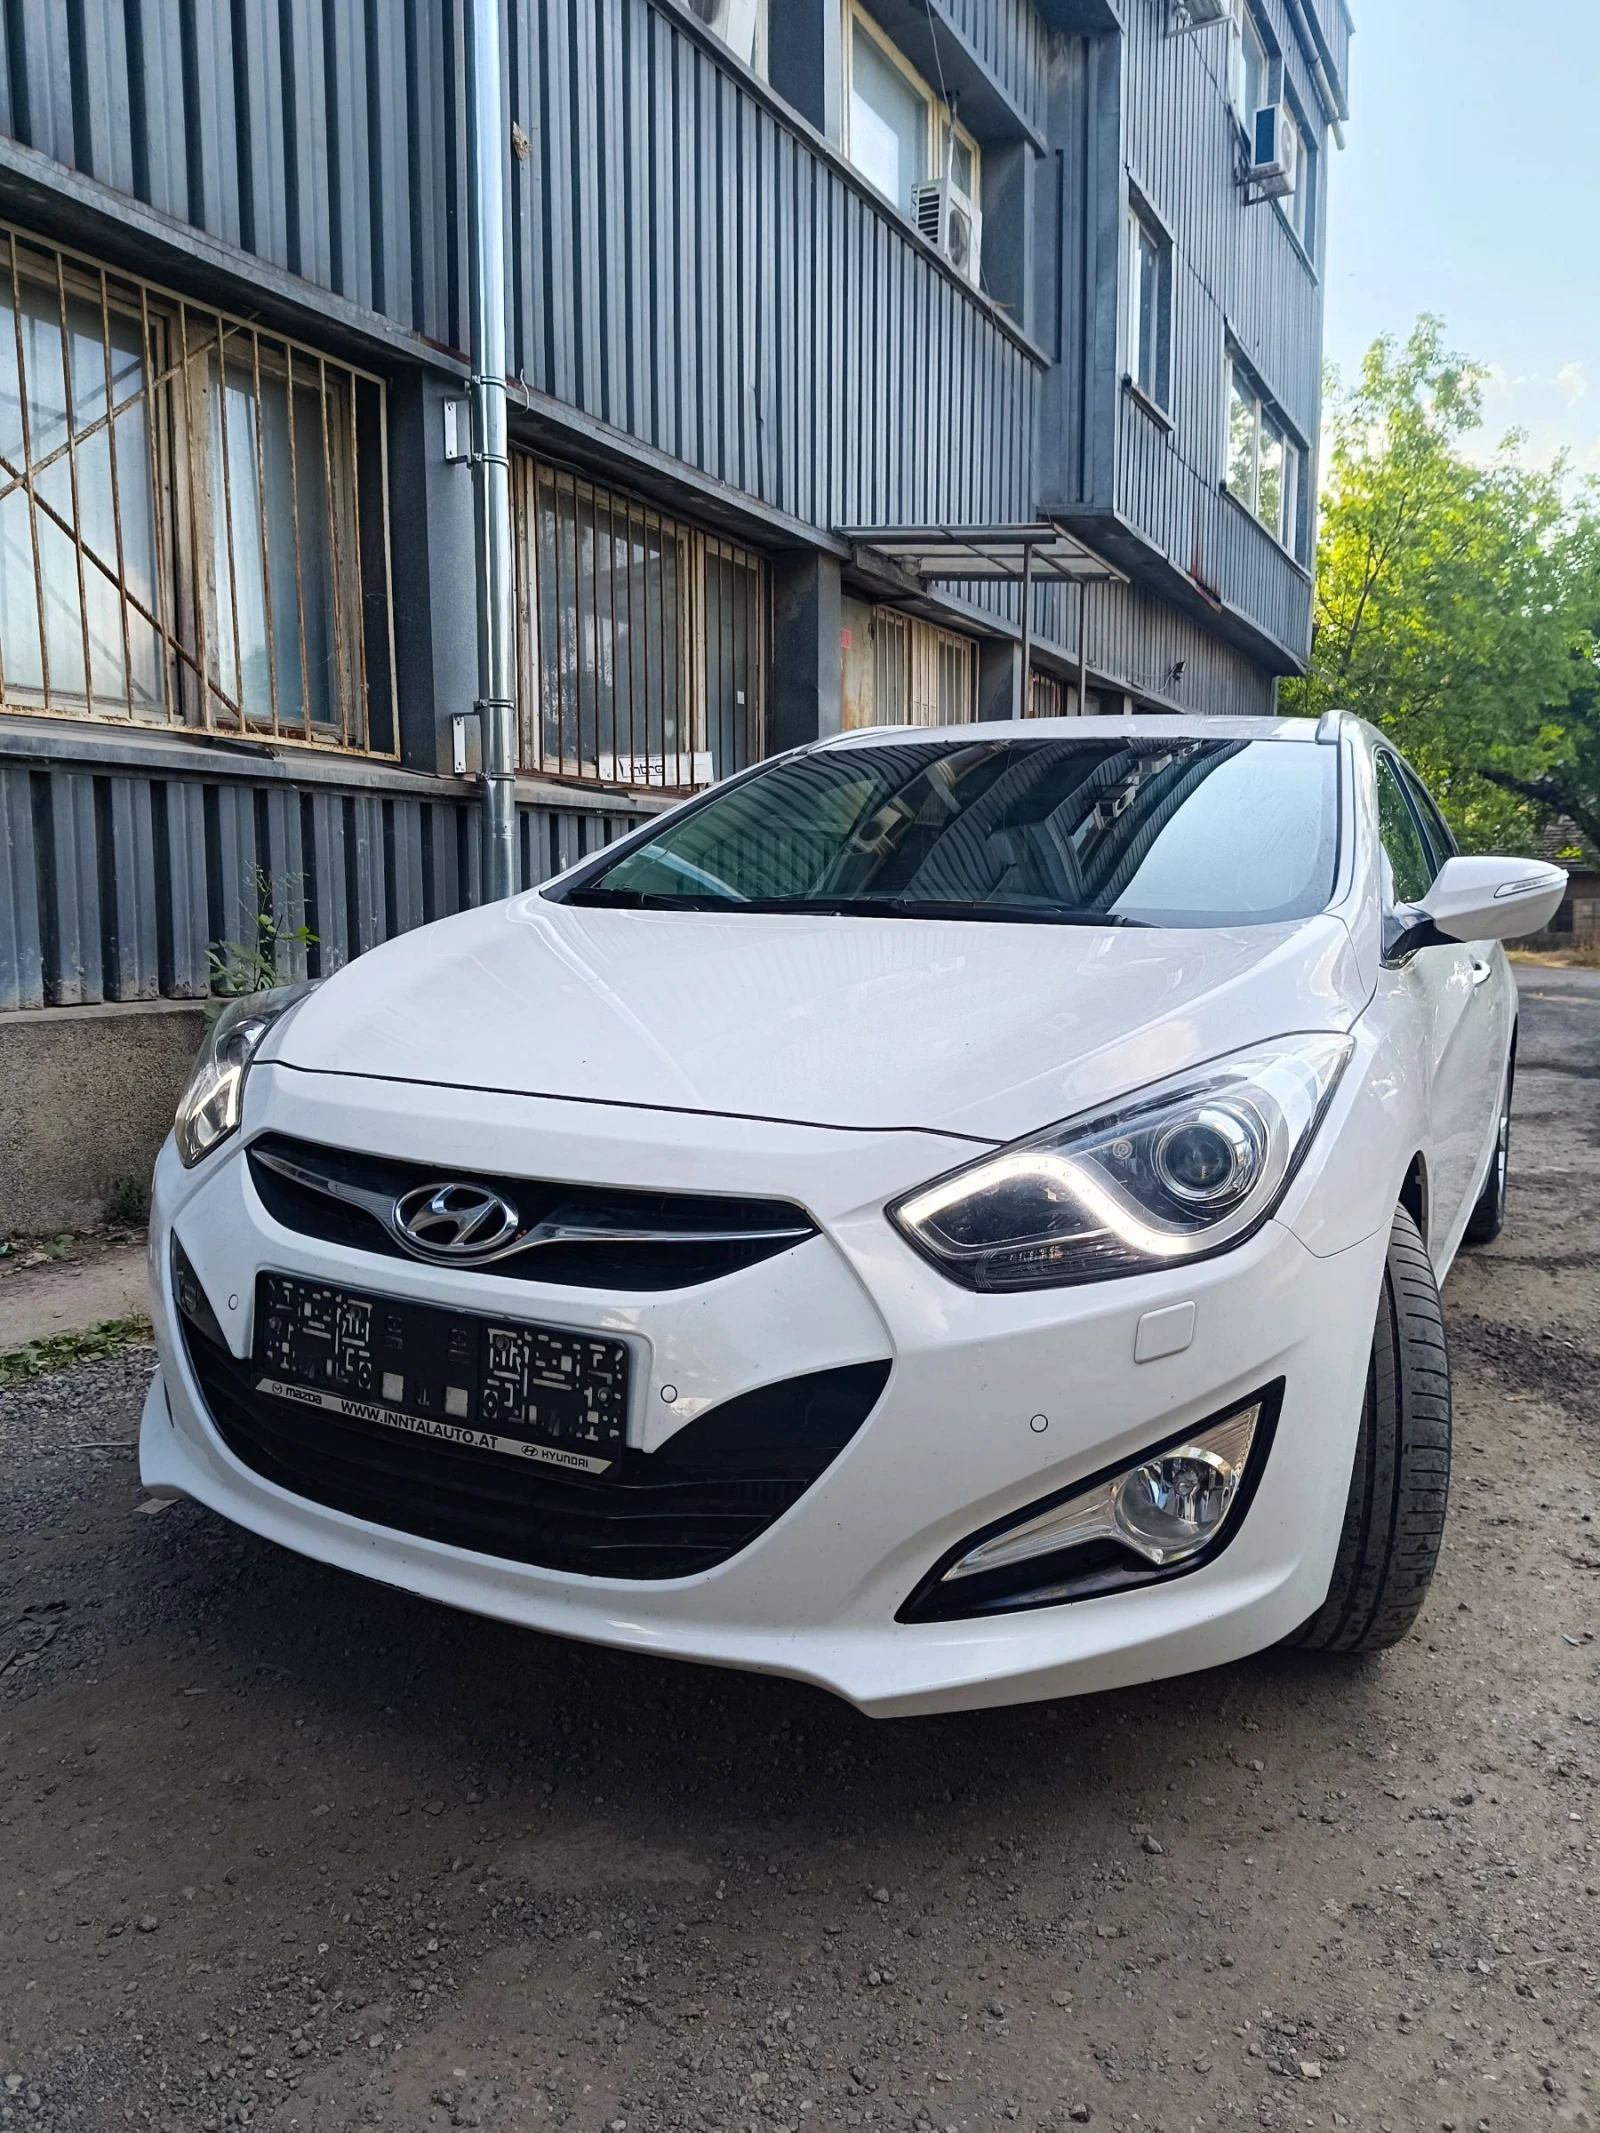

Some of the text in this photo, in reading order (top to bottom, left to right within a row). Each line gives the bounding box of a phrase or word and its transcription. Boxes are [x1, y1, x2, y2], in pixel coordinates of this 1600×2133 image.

[285, 1386, 589, 1468] mazda WWW.INNTALAUTO.AT HYUNDAI
